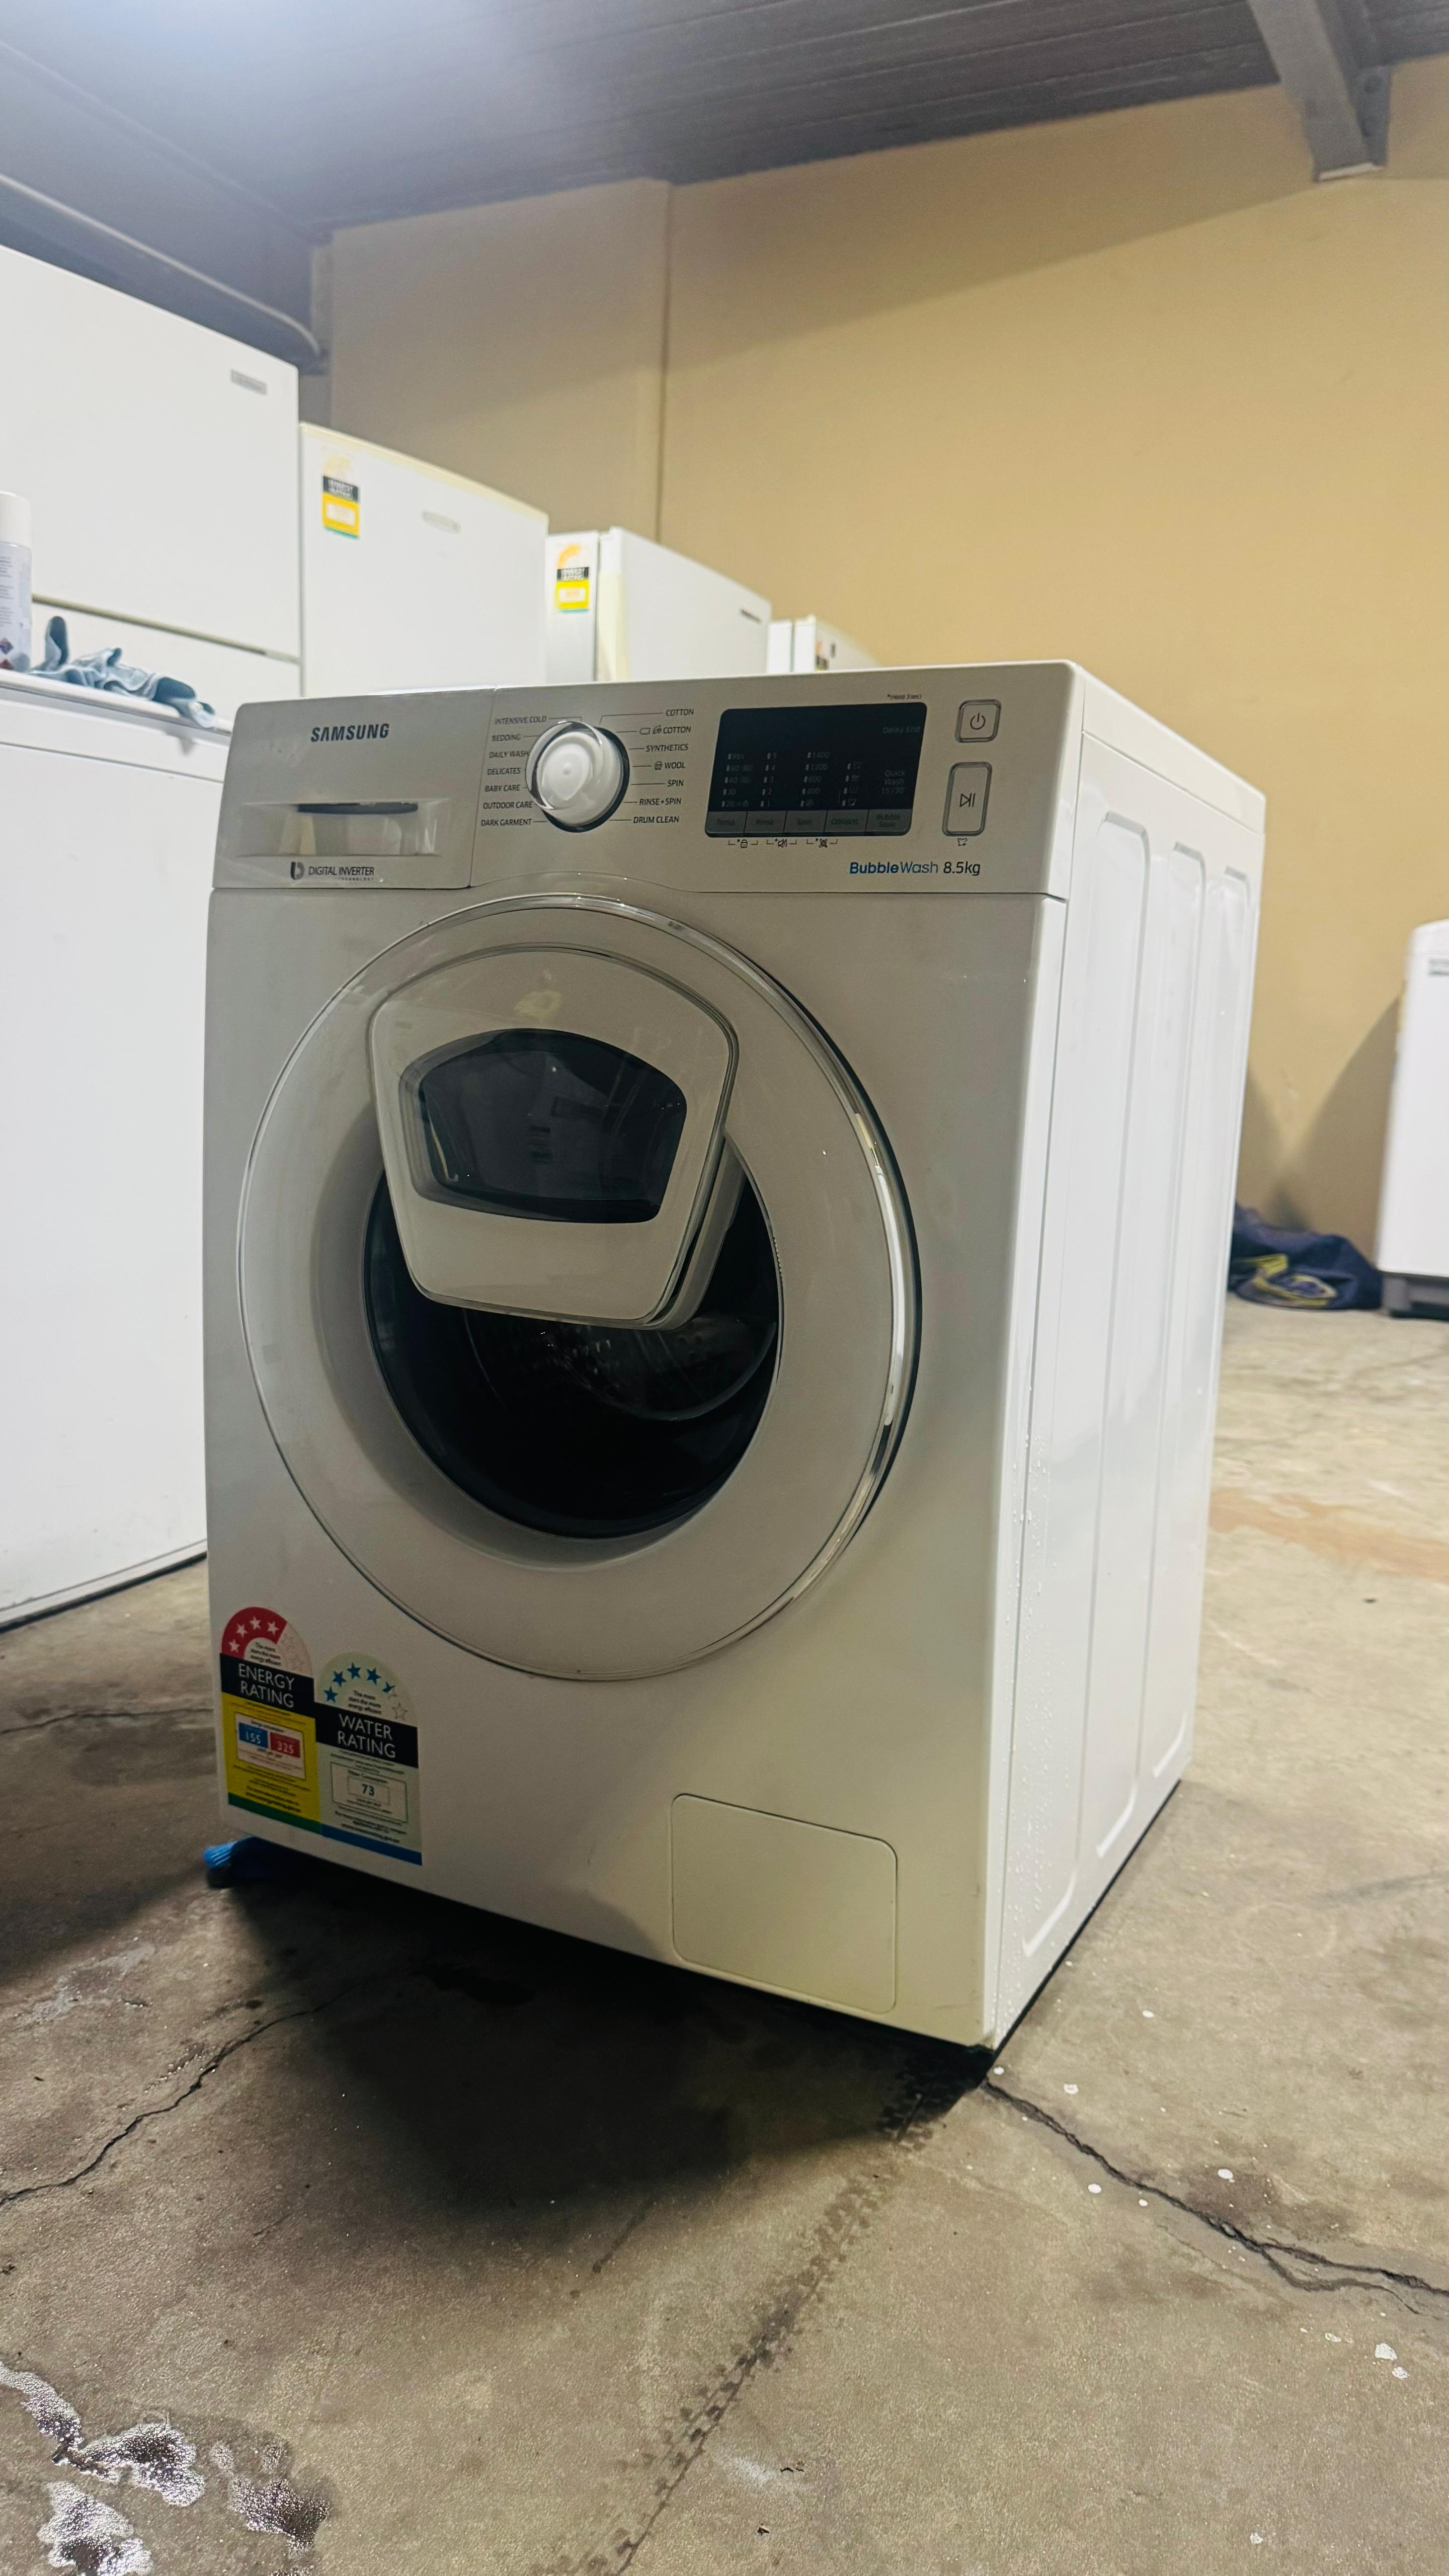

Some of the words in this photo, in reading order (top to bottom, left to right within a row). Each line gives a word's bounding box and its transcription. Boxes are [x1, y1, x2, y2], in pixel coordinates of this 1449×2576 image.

[666, 708, 694, 716] COTTON
[311, 723, 389, 742] SAMSUNG
[663, 726, 691, 734] COTTON
[646, 744, 689, 752] SYNTHETICS
[308, 866, 337, 875] DIGITAL
[339, 866, 374, 875] INVERTER
[943, 861, 981, 876] 8.5kg
[238, 1663, 295, 1691] ENERGY
[240, 1680, 294, 1708] RATING
[339, 1713, 393, 1741] WATER
[246, 1731, 261, 1744] 155
[338, 1730, 396, 1758] RATING
[277, 1741, 294, 1754] 325
[362, 1783, 375, 1797] 73
